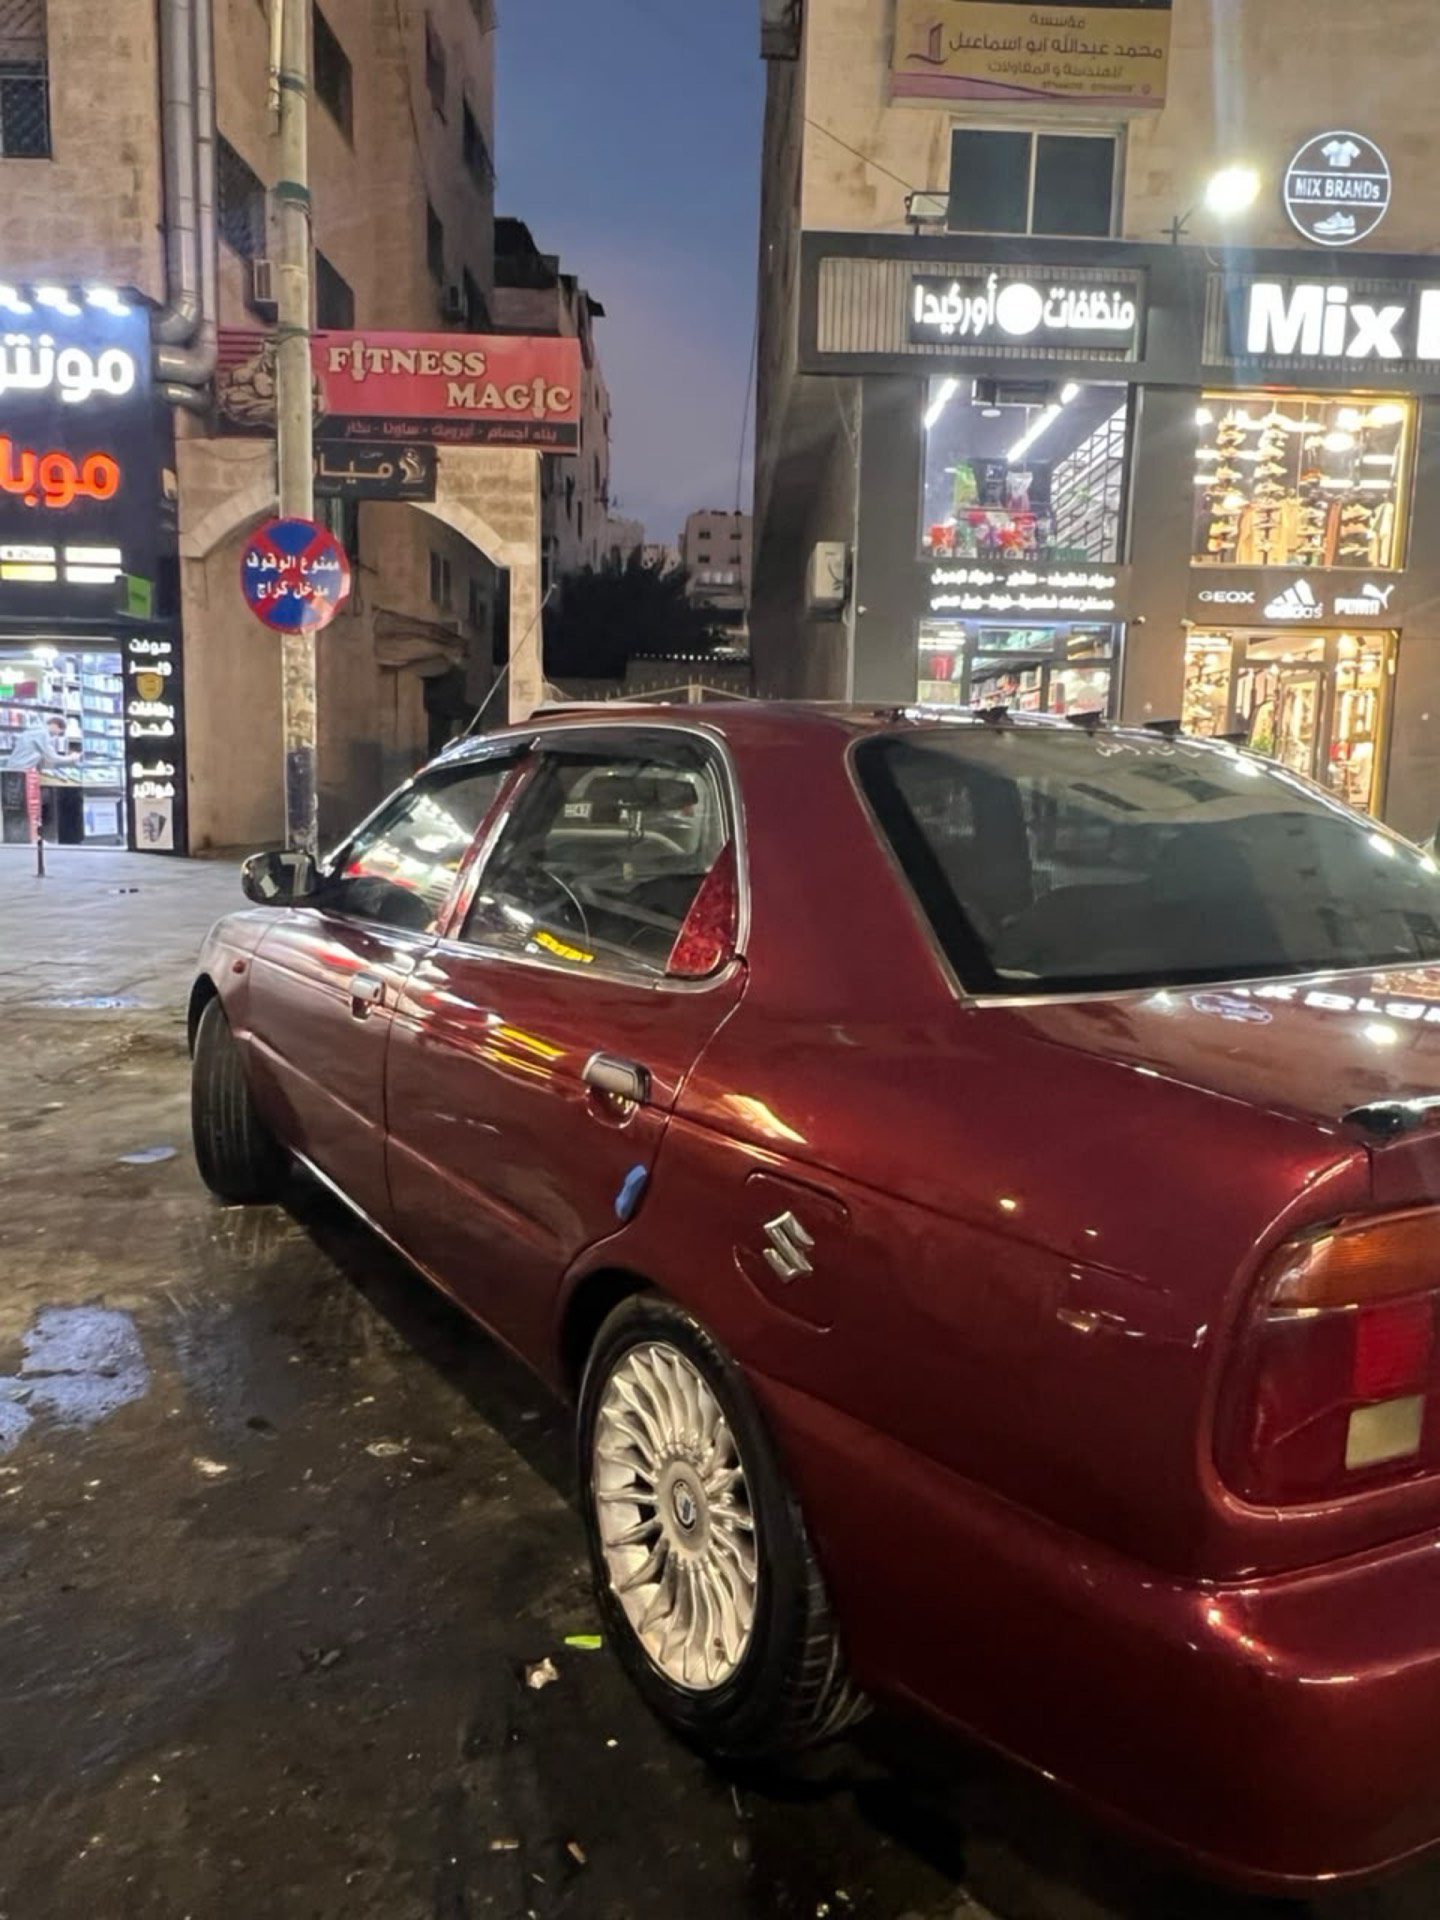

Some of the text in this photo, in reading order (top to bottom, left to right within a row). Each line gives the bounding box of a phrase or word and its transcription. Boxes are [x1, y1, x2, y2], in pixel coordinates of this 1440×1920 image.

[1029, 13, 1085, 29] مؤسسة
[949, 32, 1022, 54] اسماعيل
[1114, 45, 1163, 59] محمد
[1295, 177, 1381, 200] MIX BRANDs
[914, 272, 1136, 337] منظفات أوركيدا
[1247, 283, 1406, 359] Mix
[0, 333, 135, 403] مونت
[328, 339, 487, 383] FITNESS
[446, 377, 572, 419] MAGIC
[246, 552, 339, 575] ممنوع الوقوف
[257, 581, 329, 600] مدخل كراج
[1198, 590, 1256, 604] GEOX
[129, 638, 172, 656] سوفت
